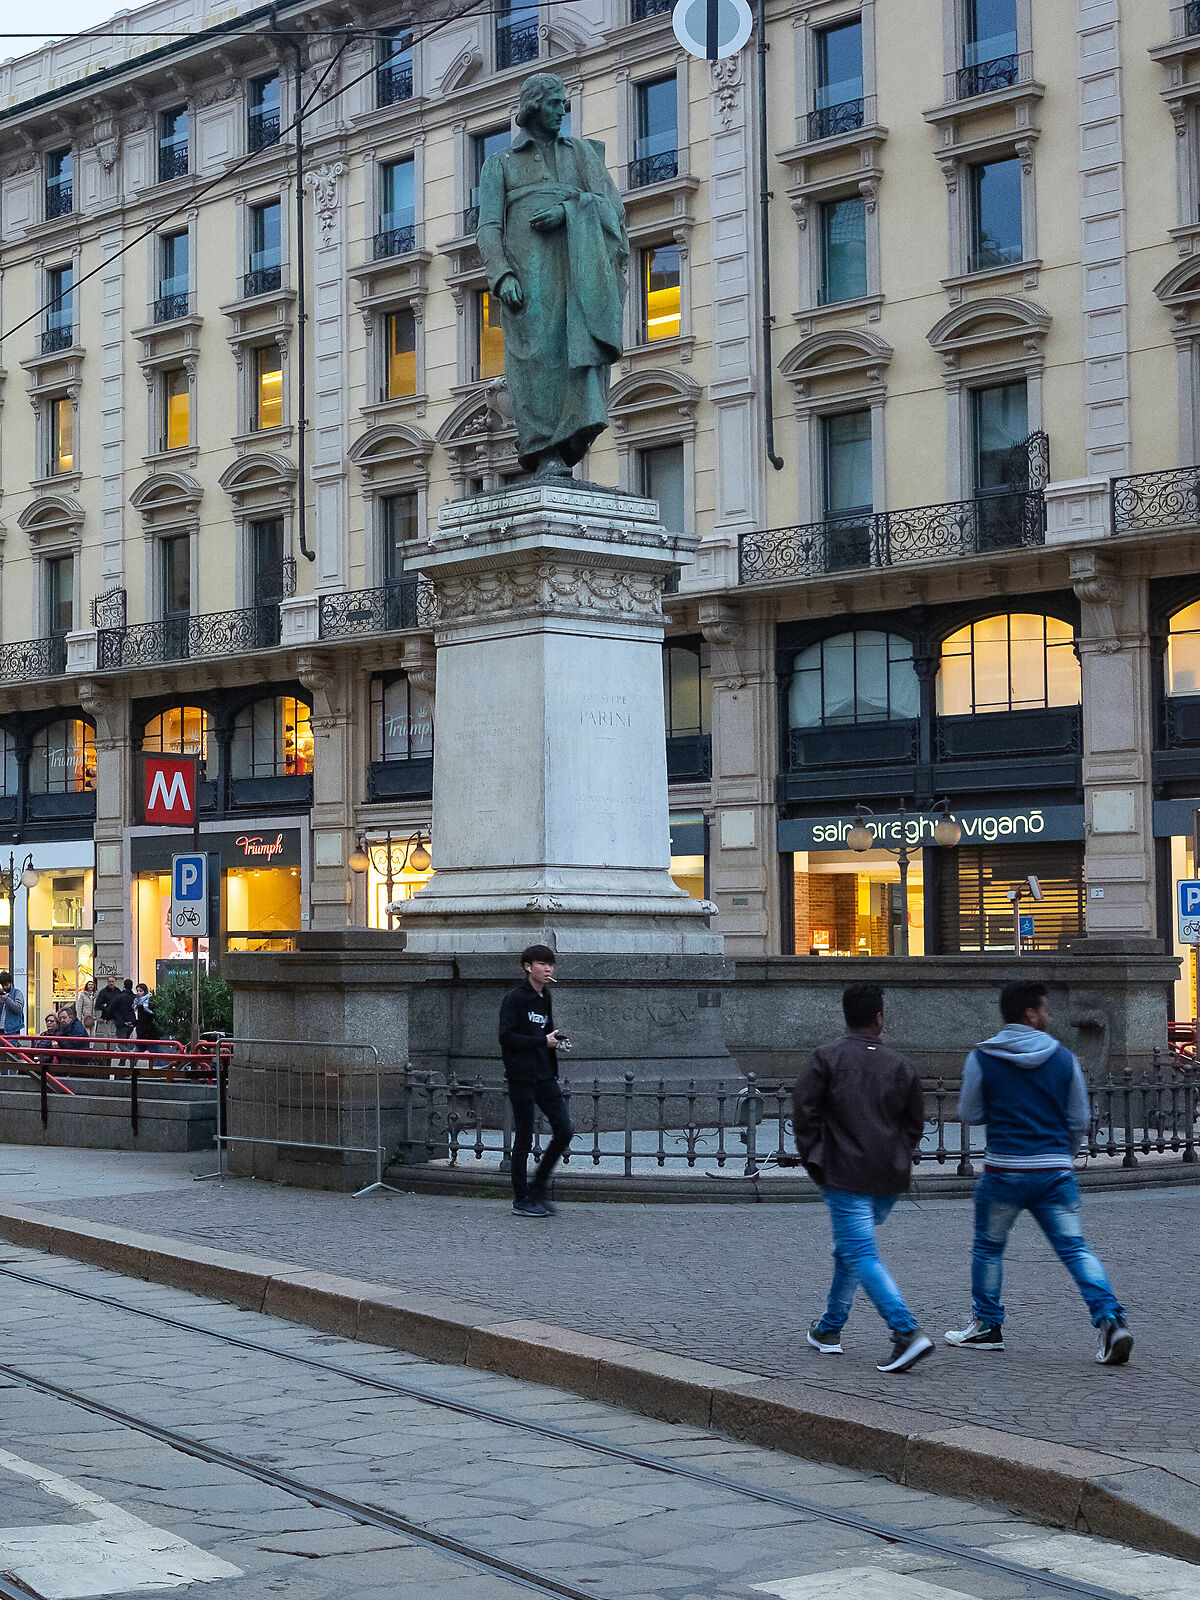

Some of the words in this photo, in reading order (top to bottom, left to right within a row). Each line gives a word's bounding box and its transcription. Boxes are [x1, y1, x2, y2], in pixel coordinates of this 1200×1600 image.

[377, 712, 433, 744] Triump
[147, 770, 192, 811] M
[236, 833, 283, 862] Triumph
[181, 863, 198, 896] P
[1187, 887, 1200, 913] P
